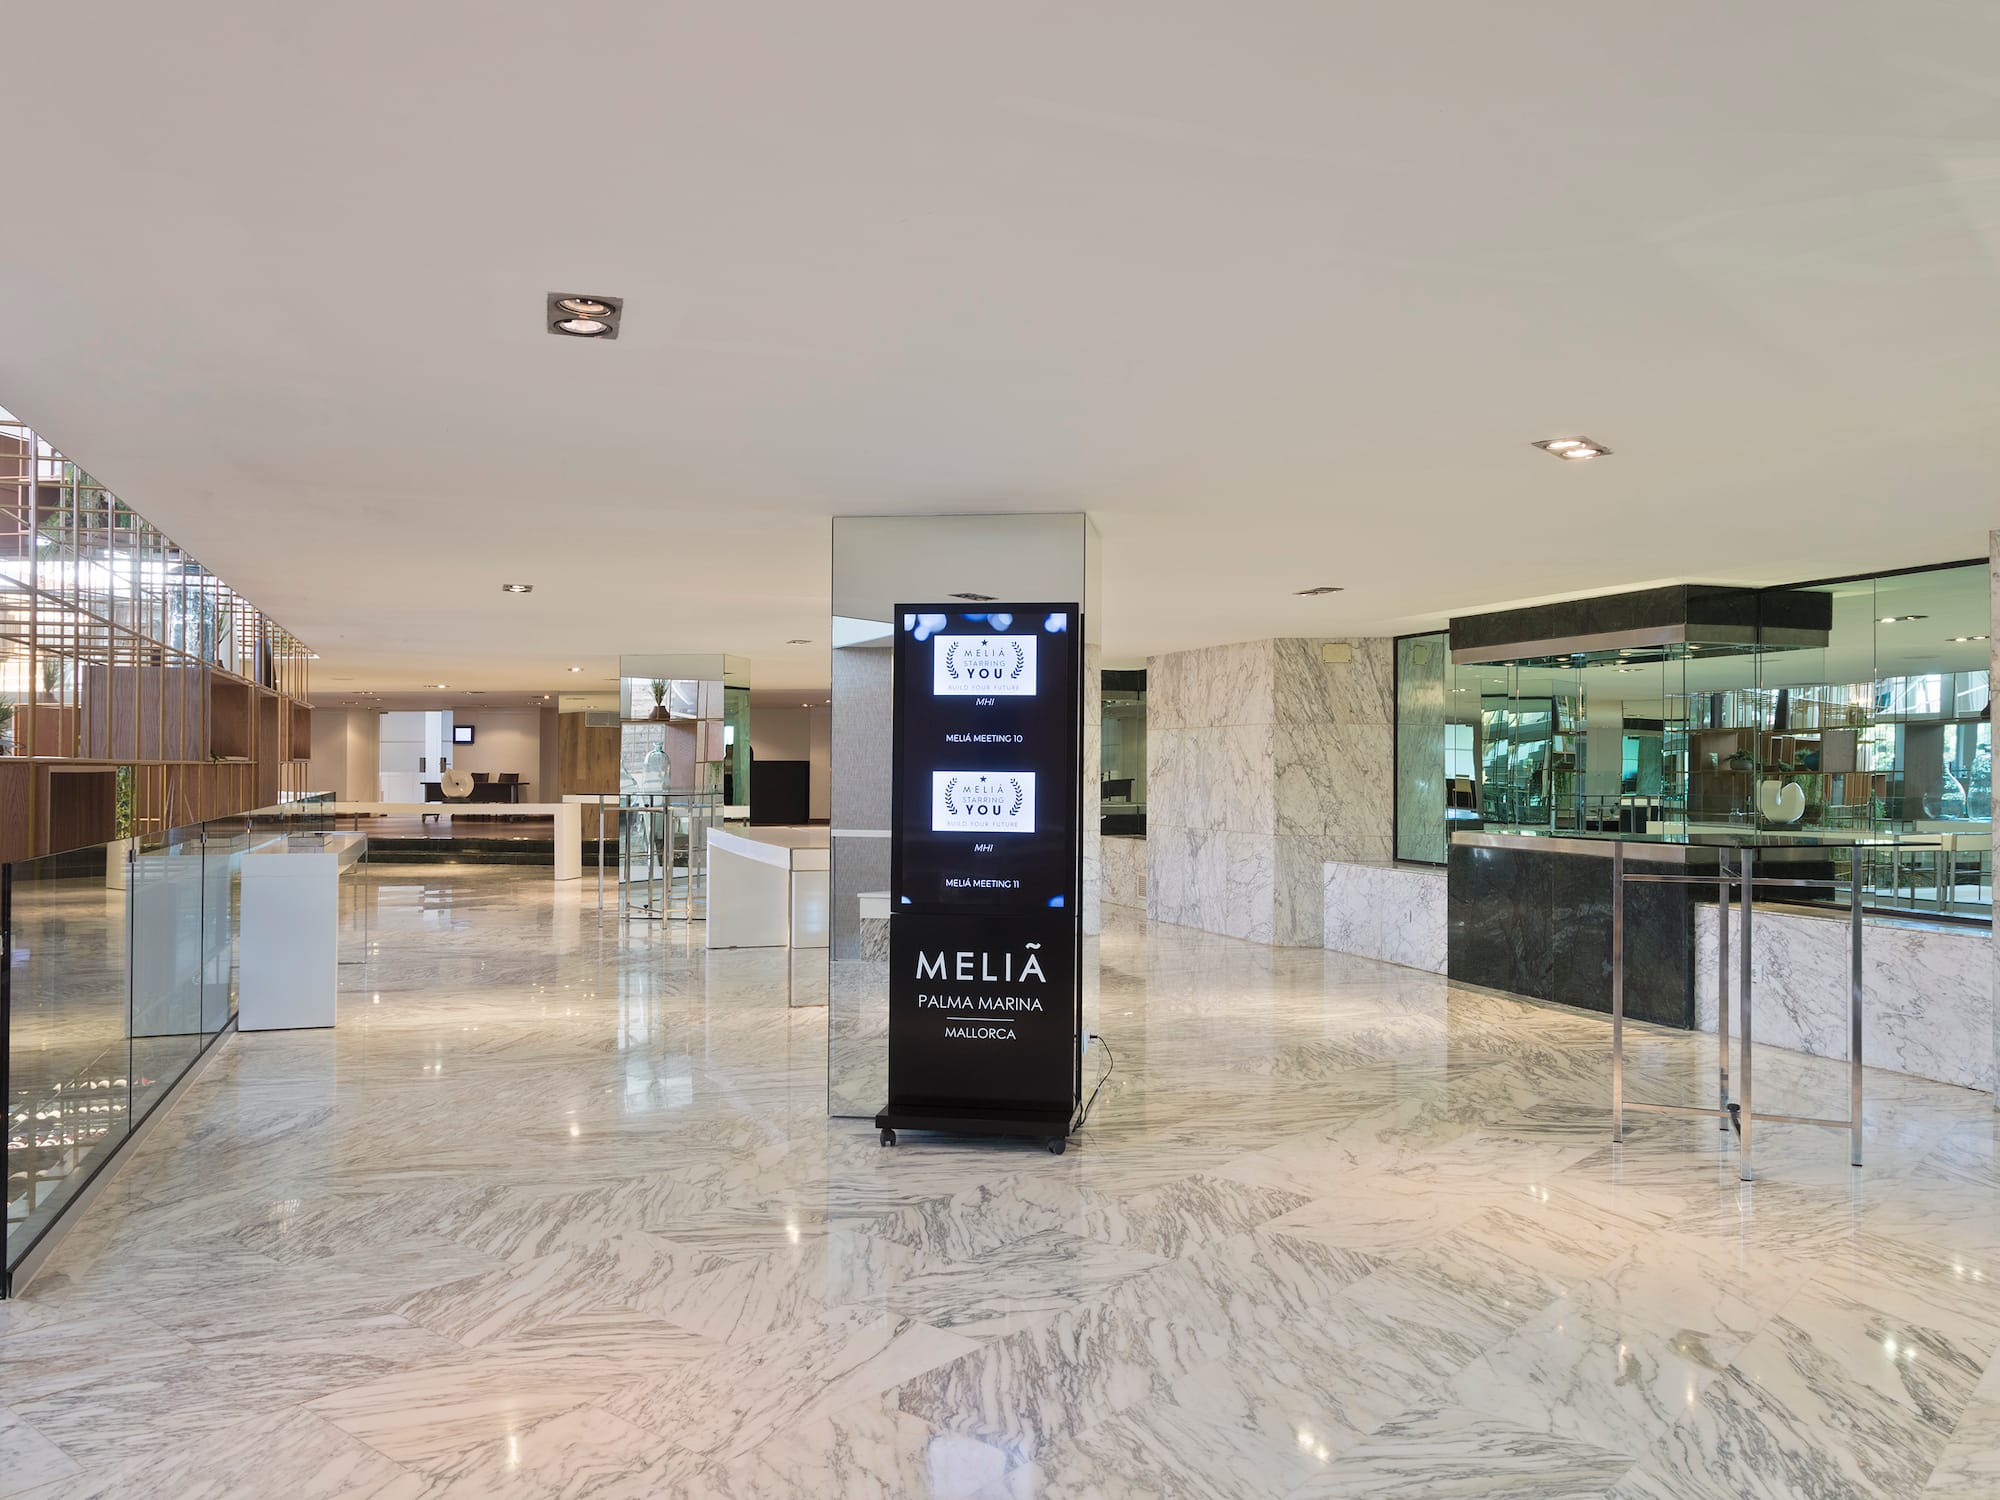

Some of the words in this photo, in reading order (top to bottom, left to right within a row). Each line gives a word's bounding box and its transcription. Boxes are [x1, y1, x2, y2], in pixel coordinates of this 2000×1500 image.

[964, 647, 1005, 657] MELIÁ
[967, 668, 1003, 679] YOU
[975, 698, 995, 706] MHI
[946, 733, 972, 743] MELIÁ
[973, 734, 1012, 743] MEETING
[1013, 734, 1023, 743] 10
[962, 784, 1004, 794] MELIÁ
[965, 805, 1002, 816] YOU
[974, 844, 994, 852] MHI
[946, 878, 971, 888] MELIÁ
[973, 879, 1012, 888] MEETING
[1013, 880, 1020, 888] 11
[918, 994, 974, 1010] PALMA
[978, 996, 1043, 1012] MARINA
[944, 1027, 1017, 1040] MALLORCA
